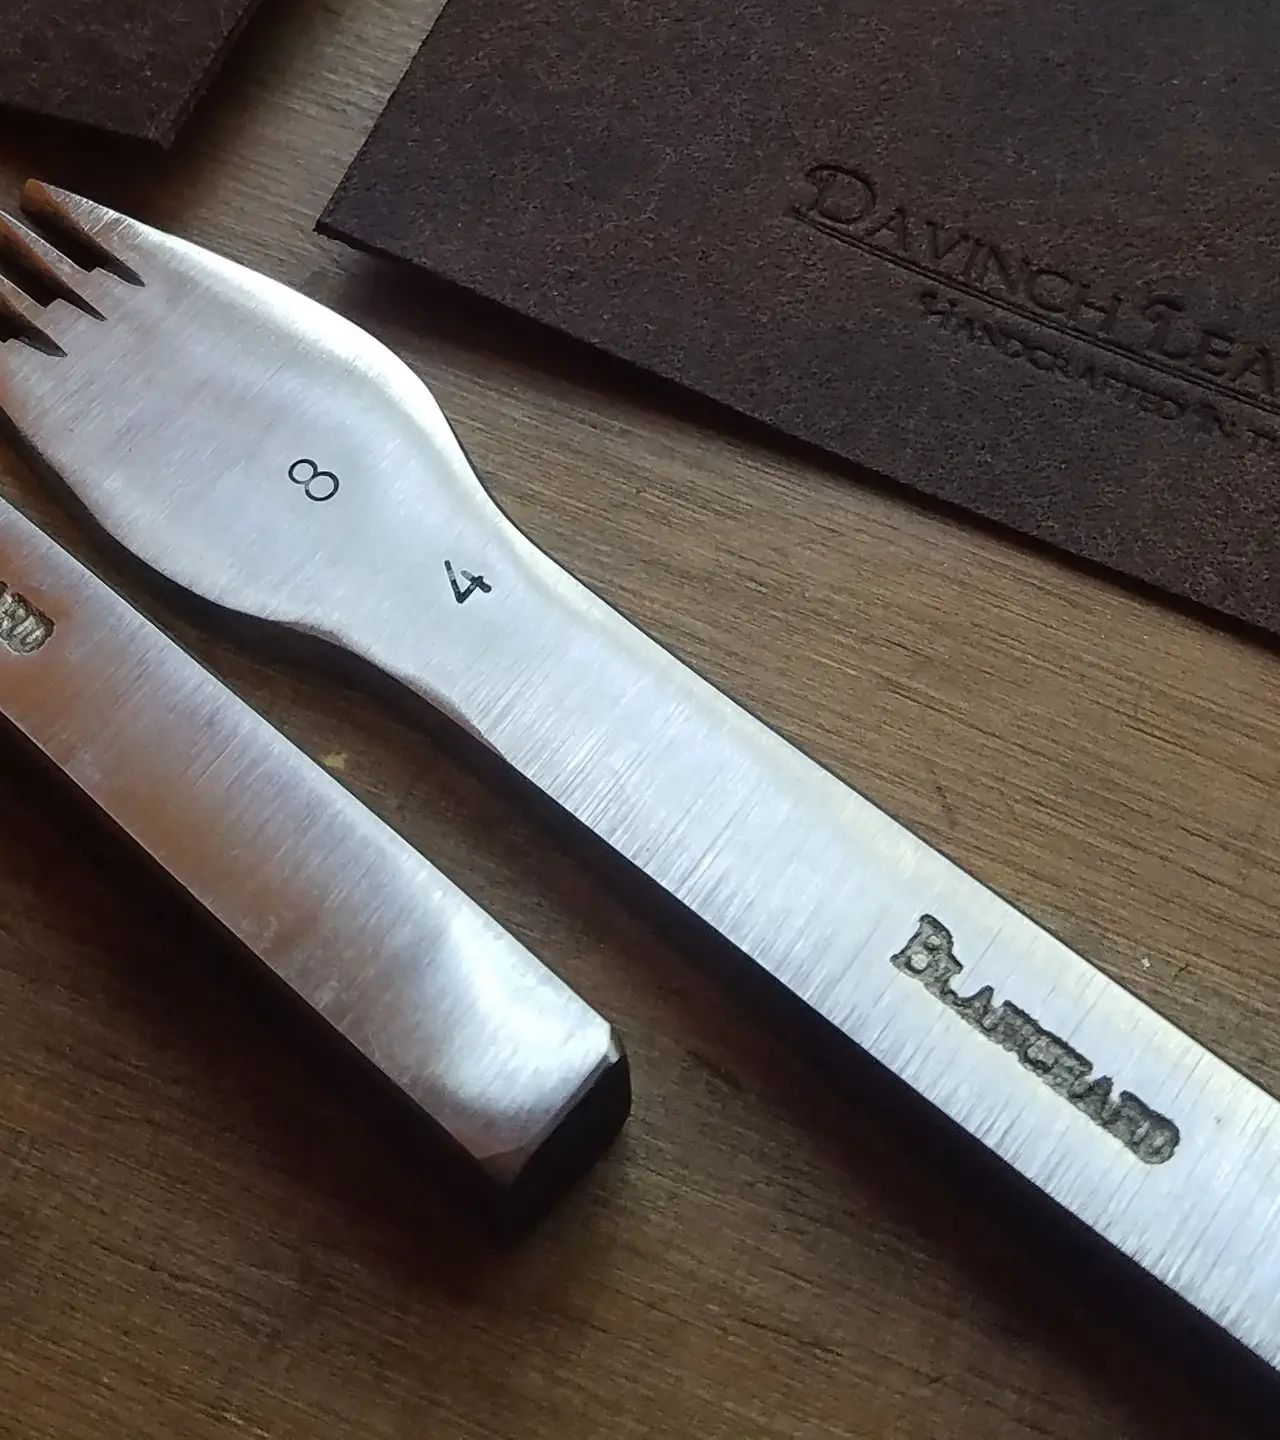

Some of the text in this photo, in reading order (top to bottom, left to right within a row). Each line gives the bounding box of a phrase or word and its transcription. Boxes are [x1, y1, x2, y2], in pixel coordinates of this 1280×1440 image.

[288, 458, 340, 501] 8
[444, 559, 492, 604] 4
[889, 913, 1181, 1164] BLANCHARD
